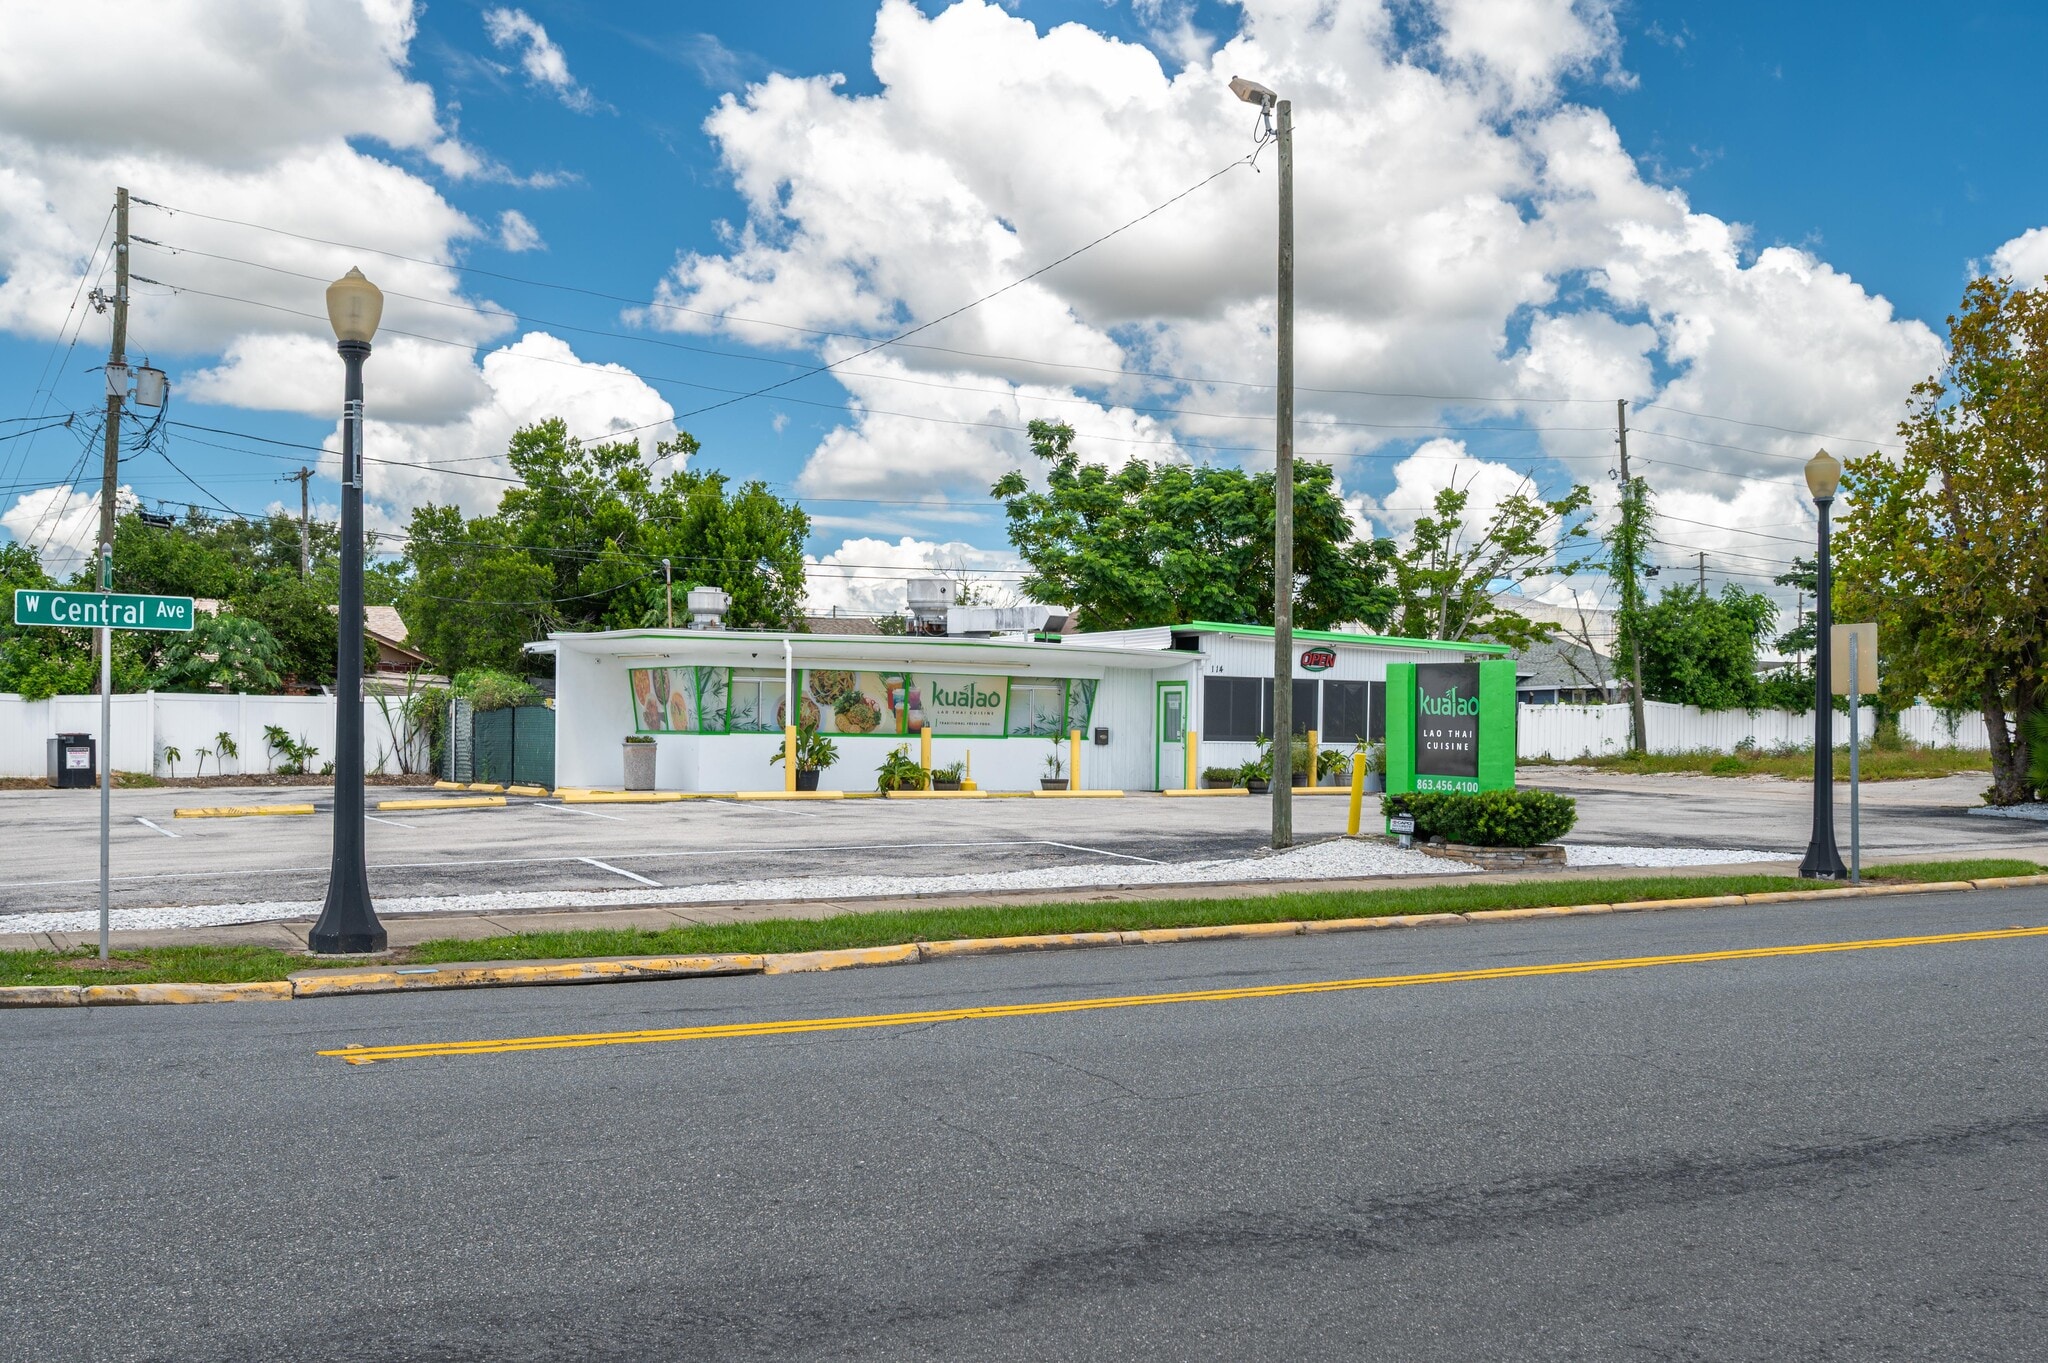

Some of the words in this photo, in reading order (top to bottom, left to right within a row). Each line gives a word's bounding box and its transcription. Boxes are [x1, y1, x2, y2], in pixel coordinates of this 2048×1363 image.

[26, 596, 39, 612] W
[51, 597, 144, 624] Central
[157, 601, 184, 618] Ave
[1301, 653, 1336, 667] OPEN
[1211, 665, 1224, 673] 114
[932, 681, 1000, 709] kualao
[1419, 686, 1479, 718] kualao
[1423, 729, 1442, 738] LAO
[1448, 729, 1473, 739] THAI
[1426, 742, 1469, 751] CUISINE
[1417, 779, 1478, 792] 863.456.4100
